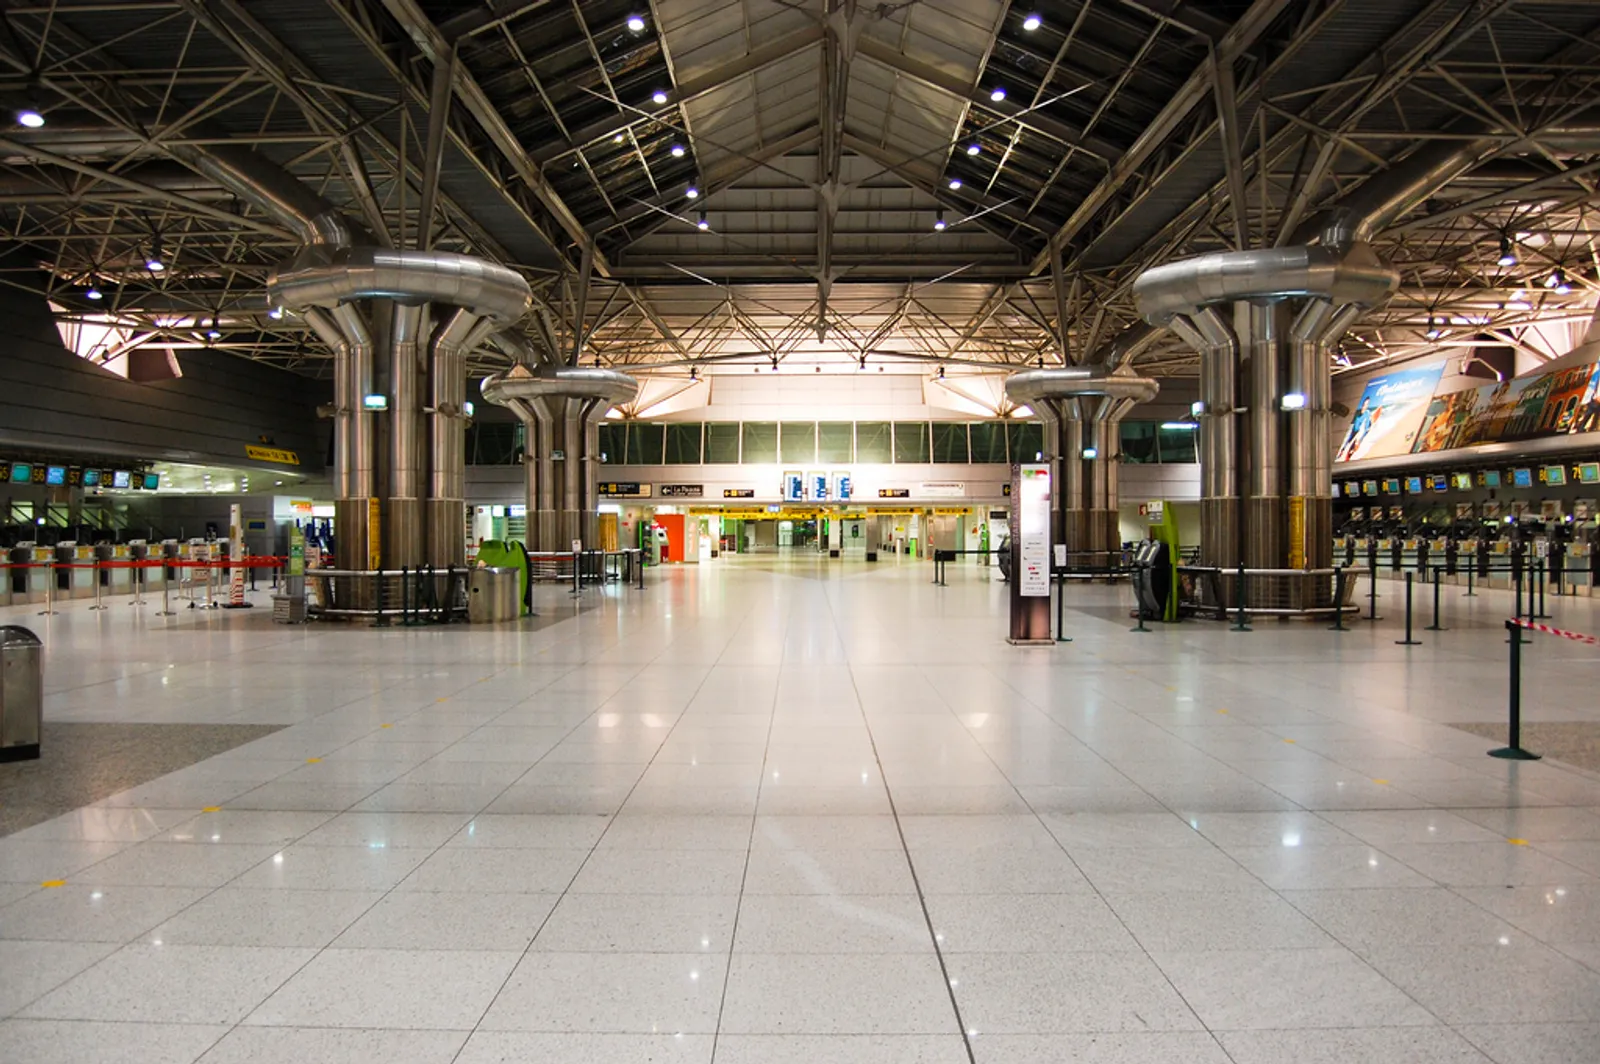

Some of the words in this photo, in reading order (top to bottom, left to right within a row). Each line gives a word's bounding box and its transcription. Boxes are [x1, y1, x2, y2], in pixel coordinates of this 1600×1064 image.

[68, 471, 81, 484] 57
[1012, 475, 1020, 519] ALLIANCE
[1012, 522, 1020, 545] STAR
